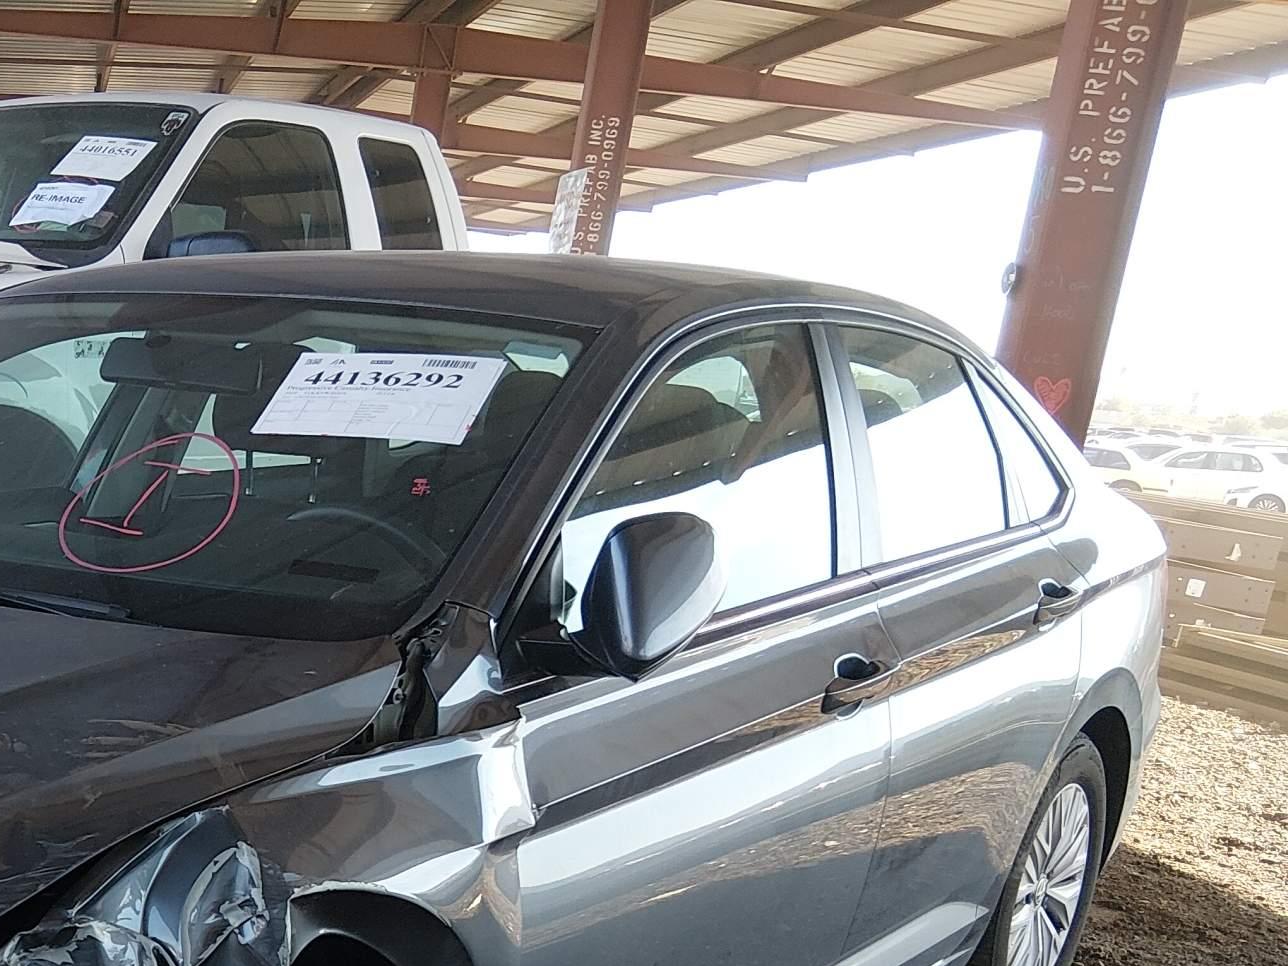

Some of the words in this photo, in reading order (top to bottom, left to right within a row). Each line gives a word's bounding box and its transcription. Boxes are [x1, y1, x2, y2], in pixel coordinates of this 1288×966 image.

[587, 113, 606, 146] INC.
[78, 143, 140, 158] 44016551
[1060, 137, 1098, 194] U.S.
[30, 192, 88, 205] RE-IMAGE
[303, 370, 465, 389] 44136292
